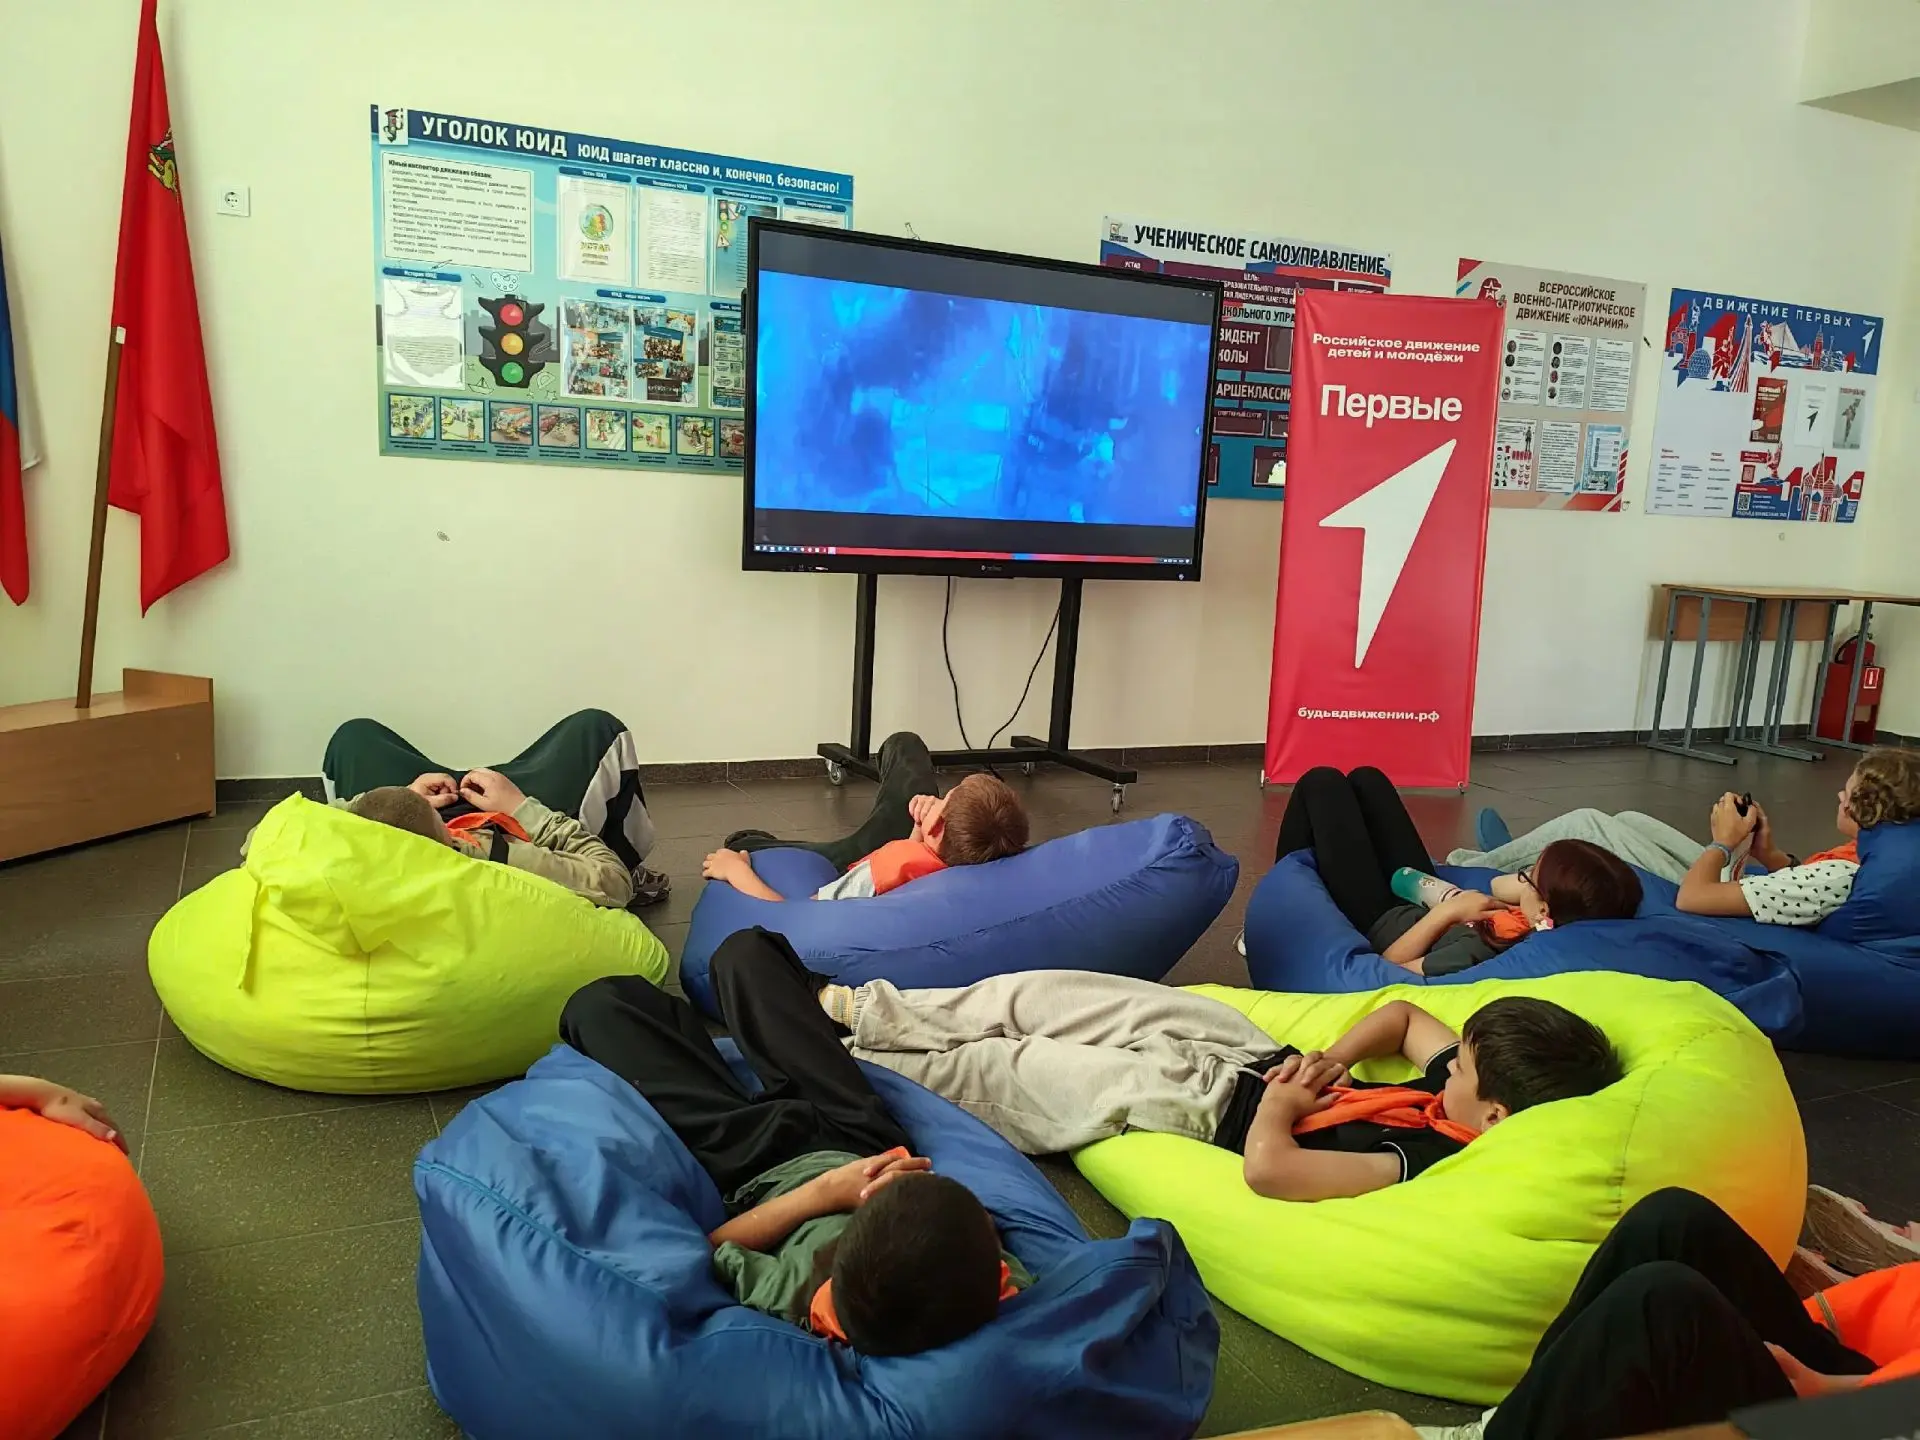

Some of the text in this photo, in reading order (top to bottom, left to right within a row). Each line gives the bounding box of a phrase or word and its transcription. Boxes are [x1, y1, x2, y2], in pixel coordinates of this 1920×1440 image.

[422, 115, 568, 158] УГОЛОК ЮИД
[578, 143, 840, 195] ЮИД шагает классно и, конечно, безопасно!
[1134, 225, 1386, 275] УЧЕНИЧЕСКОЕ САМОУПРАВЛЕНИЕ
[1538, 281, 1616, 302] ВСЕРОССИЙСКОЕ
[1513, 292, 1636, 318] ВОЕННО-ПАТРИОТИЧЕСКОЕ
[1703, 296, 1851, 327] ДВИЖЕНИЕ ПЕРВЫХ
[1516, 307, 1629, 330] ДВИЖЕНИЕ «ЮНАРМИЯ»
[1312, 332, 1480, 353] Российское движение
[1328, 346, 1464, 363] детей и молодёжи
[1320, 384, 1463, 428] Первые
[1297, 707, 1440, 722] будьвдвижении.рф
